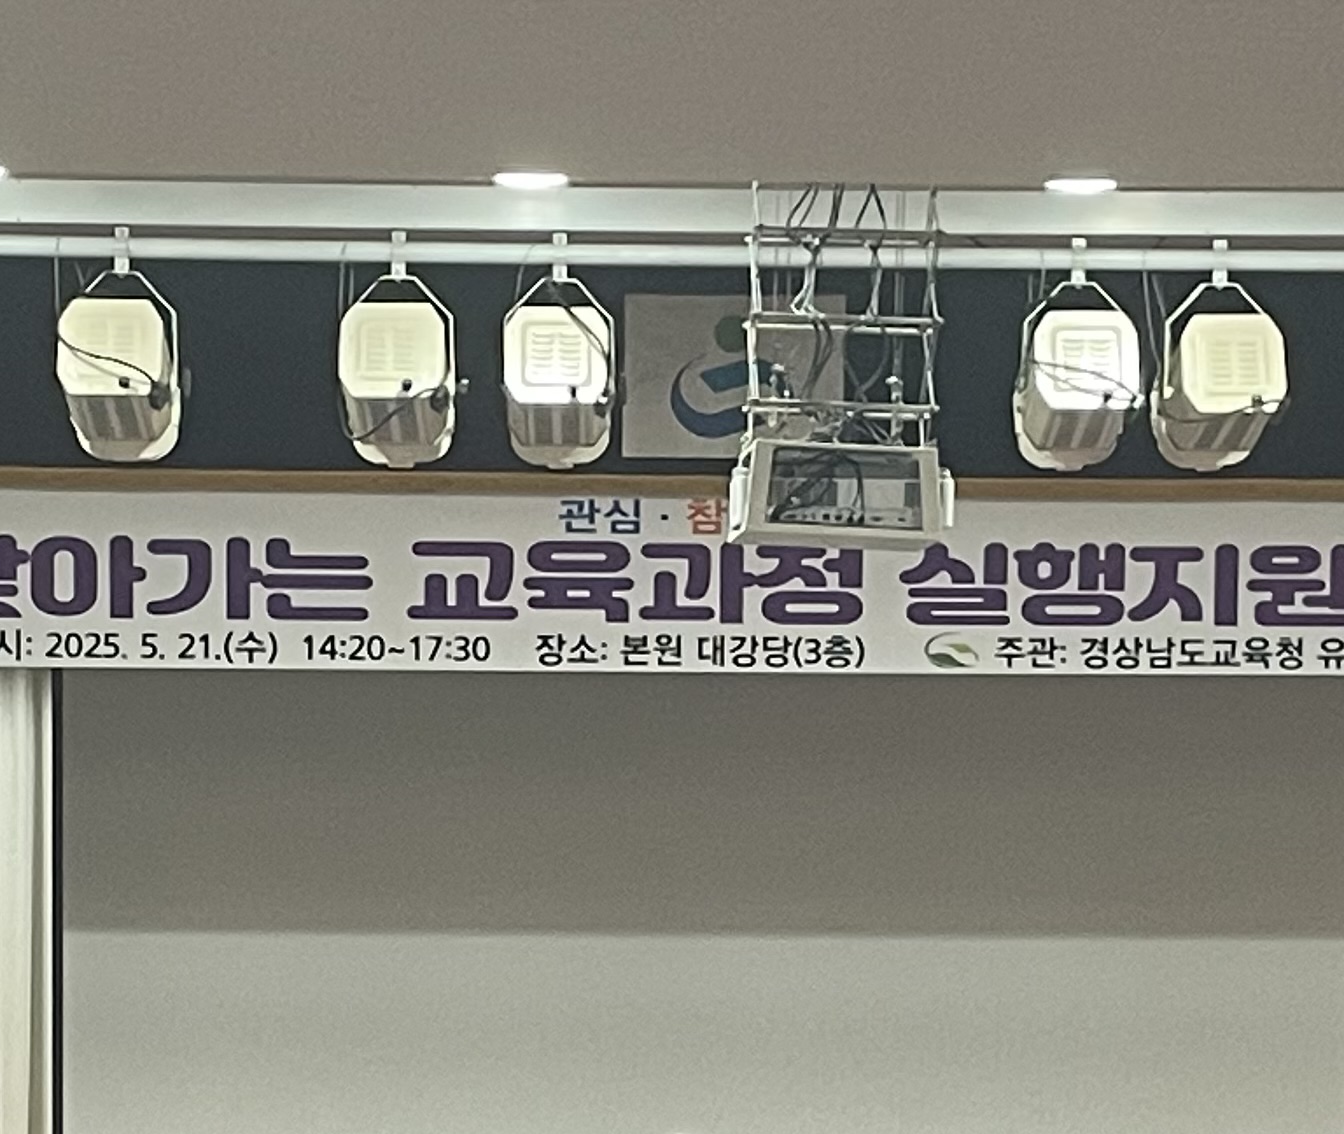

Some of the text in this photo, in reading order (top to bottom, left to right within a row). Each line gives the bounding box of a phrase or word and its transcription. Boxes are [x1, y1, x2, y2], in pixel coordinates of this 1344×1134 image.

[558, 498, 642, 535] 관심
[406, 539, 864, 626] 교육과정
[45, 632, 129, 661] 2025.
[140, 632, 166, 661] 5.
[177, 630, 278, 664] 21.(수)
[303, 633, 491, 662] 14:20~17:30
[535, 633, 865, 668] 장소: 본원 대강당(3층)
[993, 637, 1067, 668] 주관:
[1080, 637, 1304, 669] 경상남도교육청
